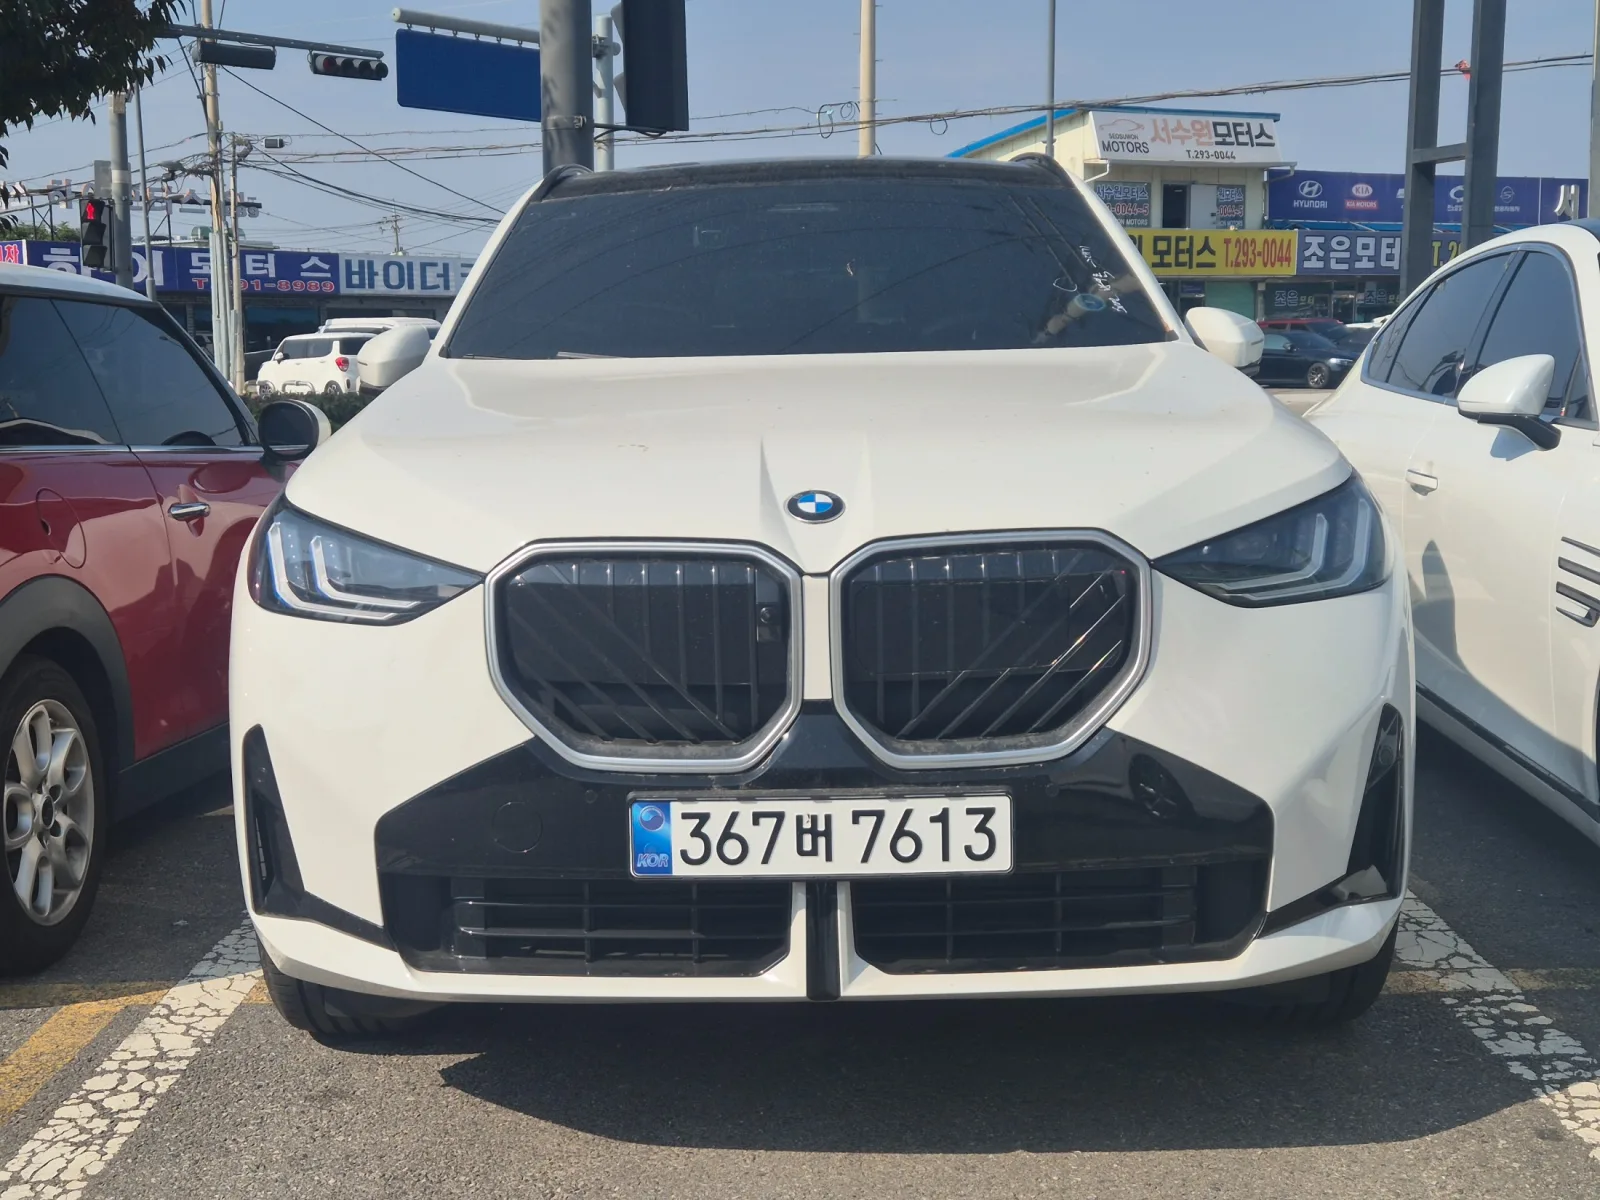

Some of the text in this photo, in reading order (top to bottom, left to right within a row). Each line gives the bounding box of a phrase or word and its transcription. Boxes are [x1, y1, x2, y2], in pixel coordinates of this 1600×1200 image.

[1102, 140, 1150, 154] MOTORS
[1186, 149, 1236, 160] T.293-0044
[1096, 184, 1149, 200] 서수원모터스
[1355, 186, 1371, 195] KIA
[1293, 200, 1328, 209] HYUNDAI
[1126, 219, 1148, 227] MOTORS
[1151, 235, 1217, 269] 모터스
[1224, 238, 1292, 268] T.293-0044
[851, 807, 997, 864] 7613
[636, 852, 669, 869] KOR
